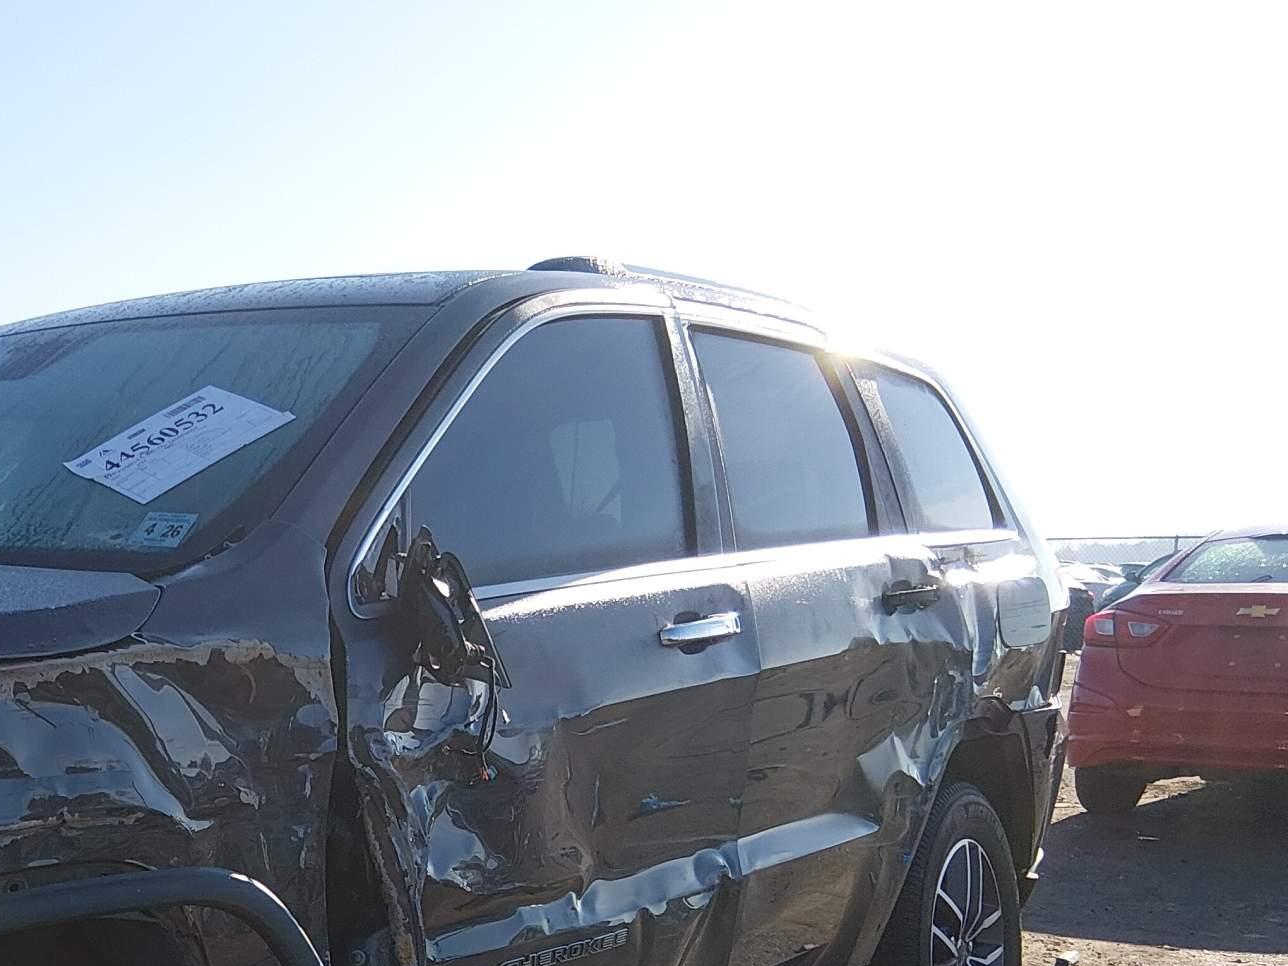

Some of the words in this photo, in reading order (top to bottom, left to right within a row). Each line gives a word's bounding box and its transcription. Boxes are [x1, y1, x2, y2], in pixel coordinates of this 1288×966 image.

[104, 402, 225, 472] 44560532
[144, 522, 158, 537] 4
[159, 523, 185, 539] 26
